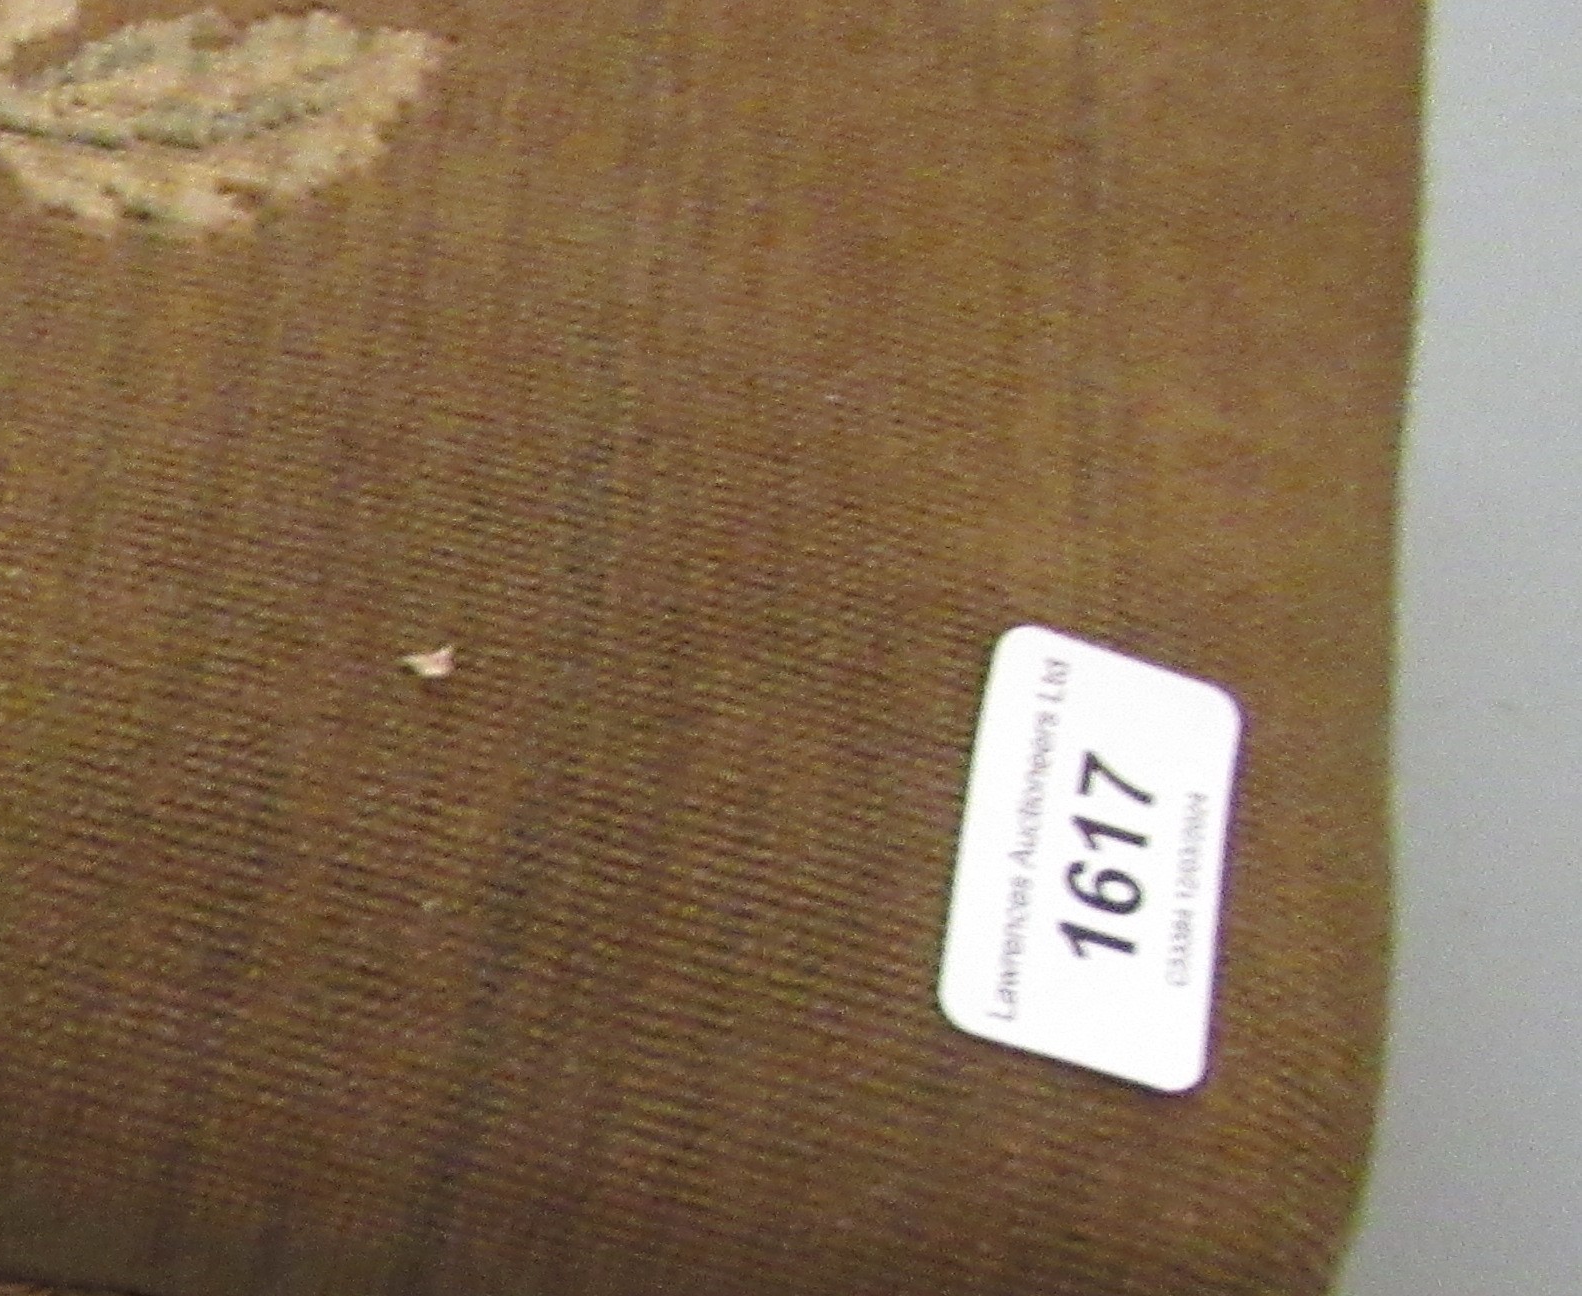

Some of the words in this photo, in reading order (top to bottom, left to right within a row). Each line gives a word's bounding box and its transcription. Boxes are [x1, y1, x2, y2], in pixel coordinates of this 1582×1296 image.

[1041, 657, 1071, 703] Ltd
[1008, 710, 1061, 870] Auctioneers
[1057, 750, 1156, 958] 1617
[987, 874, 1034, 1022] Lawrences
